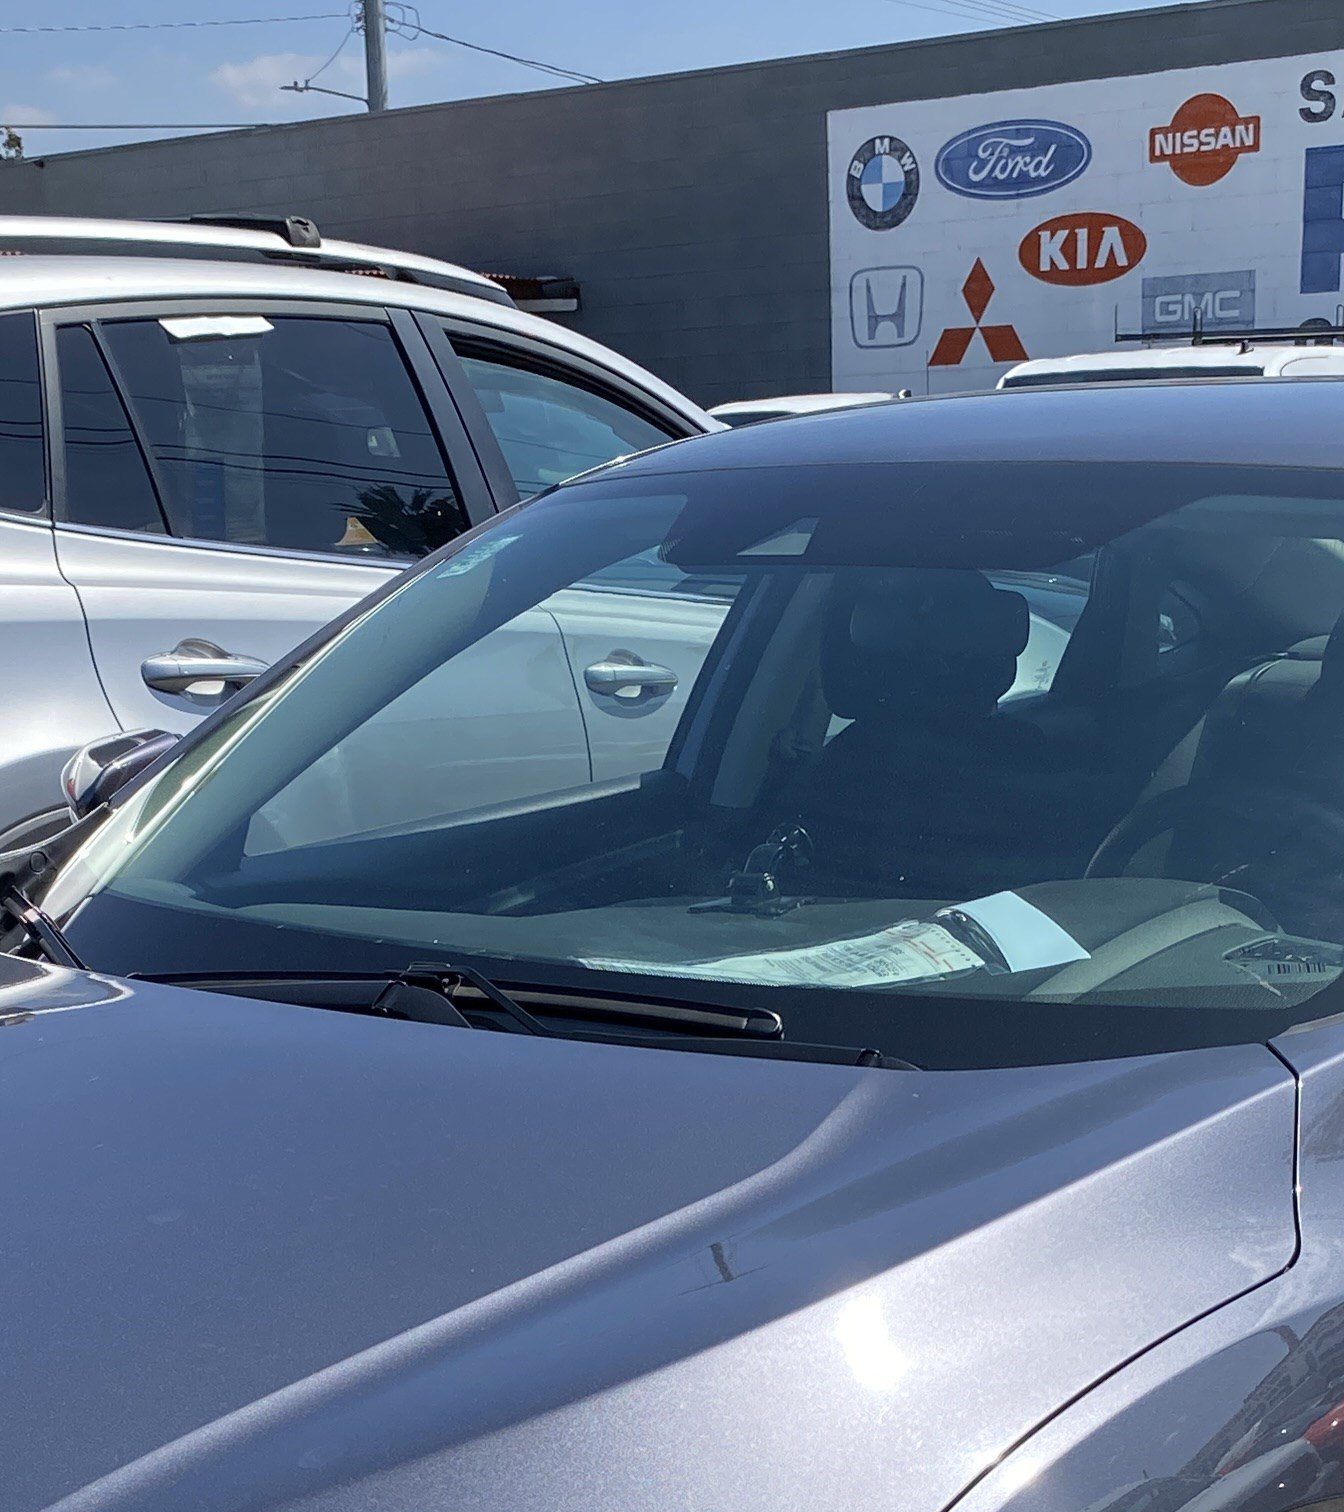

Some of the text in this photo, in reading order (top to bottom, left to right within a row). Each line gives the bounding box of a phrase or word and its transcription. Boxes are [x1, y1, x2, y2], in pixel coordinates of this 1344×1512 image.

[849, 137, 917, 179] BMW
[967, 137, 1056, 182] Ford
[1153, 123, 1255, 156] NISSAN
[1037, 225, 1130, 272] KIA
[1154, 290, 1242, 322] GMC
